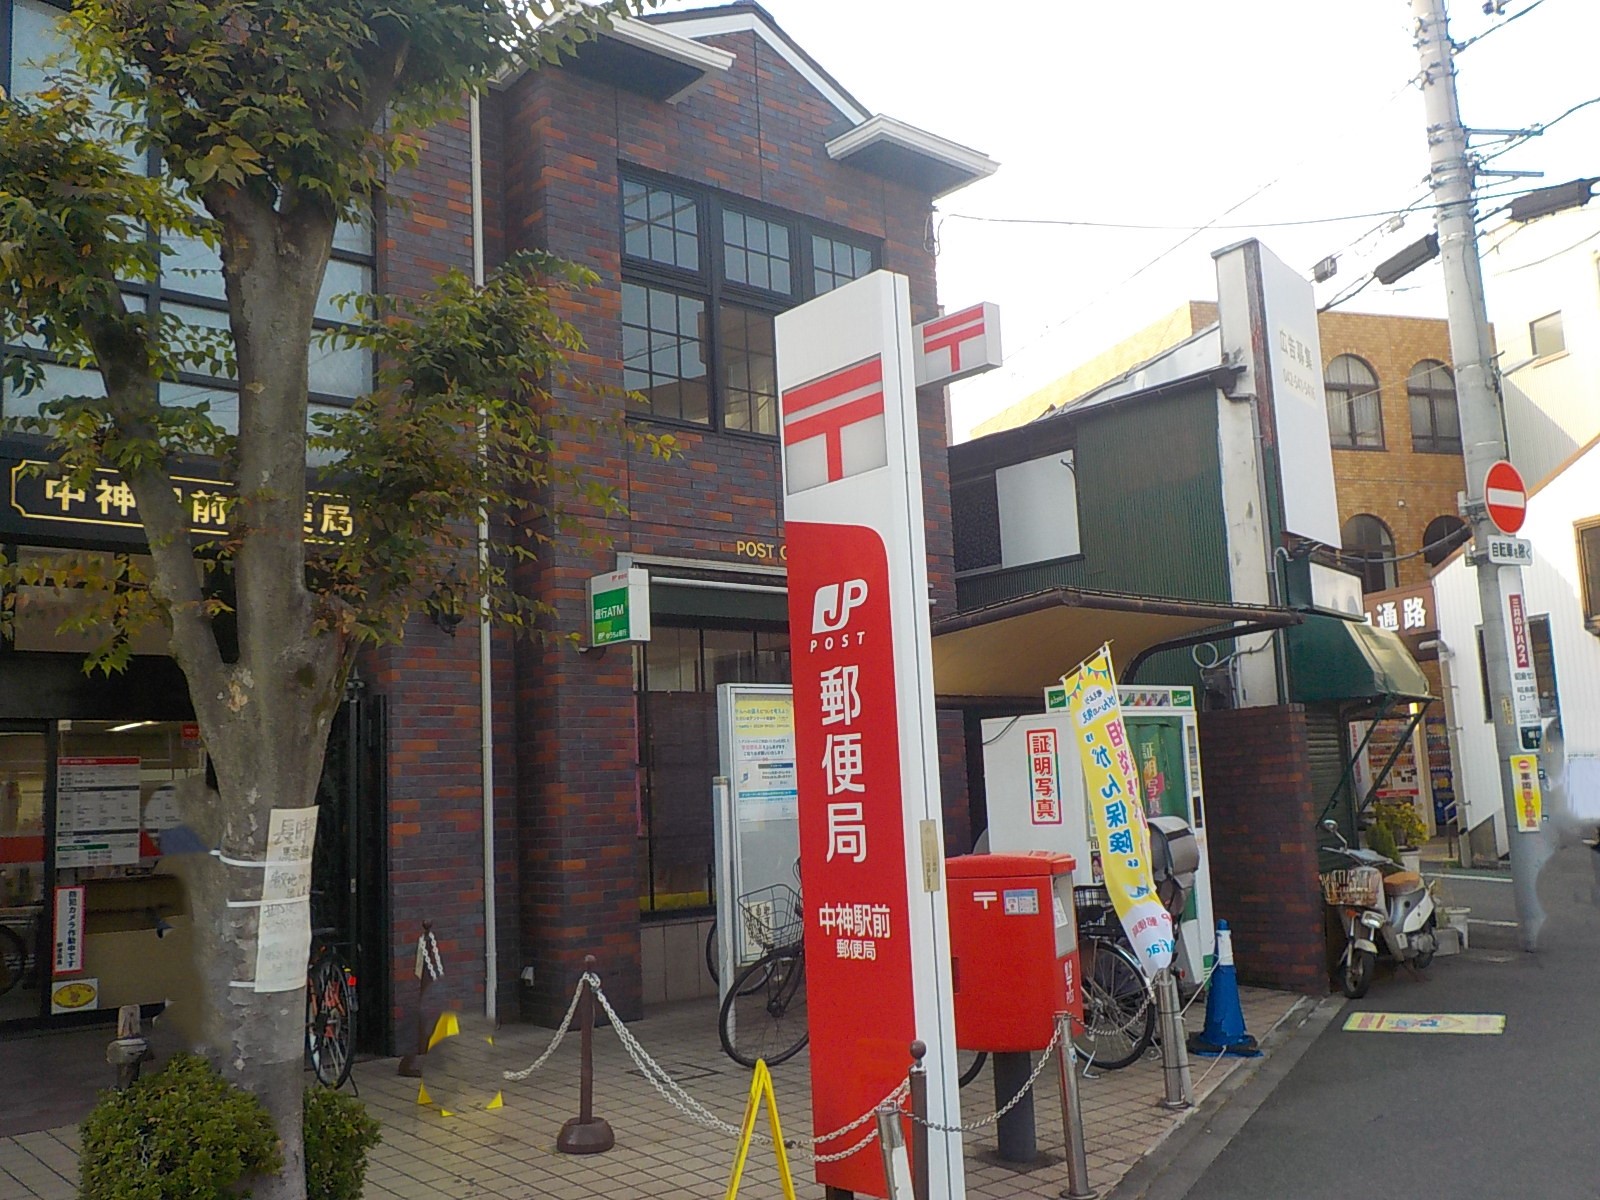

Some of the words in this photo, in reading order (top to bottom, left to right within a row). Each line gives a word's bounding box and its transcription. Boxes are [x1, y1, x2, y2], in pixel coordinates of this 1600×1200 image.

[736, 540, 775, 559] POST
[1491, 541, 1531, 560] 自転車を除く
[810, 631, 866, 653] POST
[1511, 597, 1527, 664] 三井のリハウス
[820, 664, 867, 864] 郵便局
[1032, 735, 1056, 819] 証明写真
[818, 902, 891, 939] 中神駅前
[836, 938, 876, 961] 郵便局
